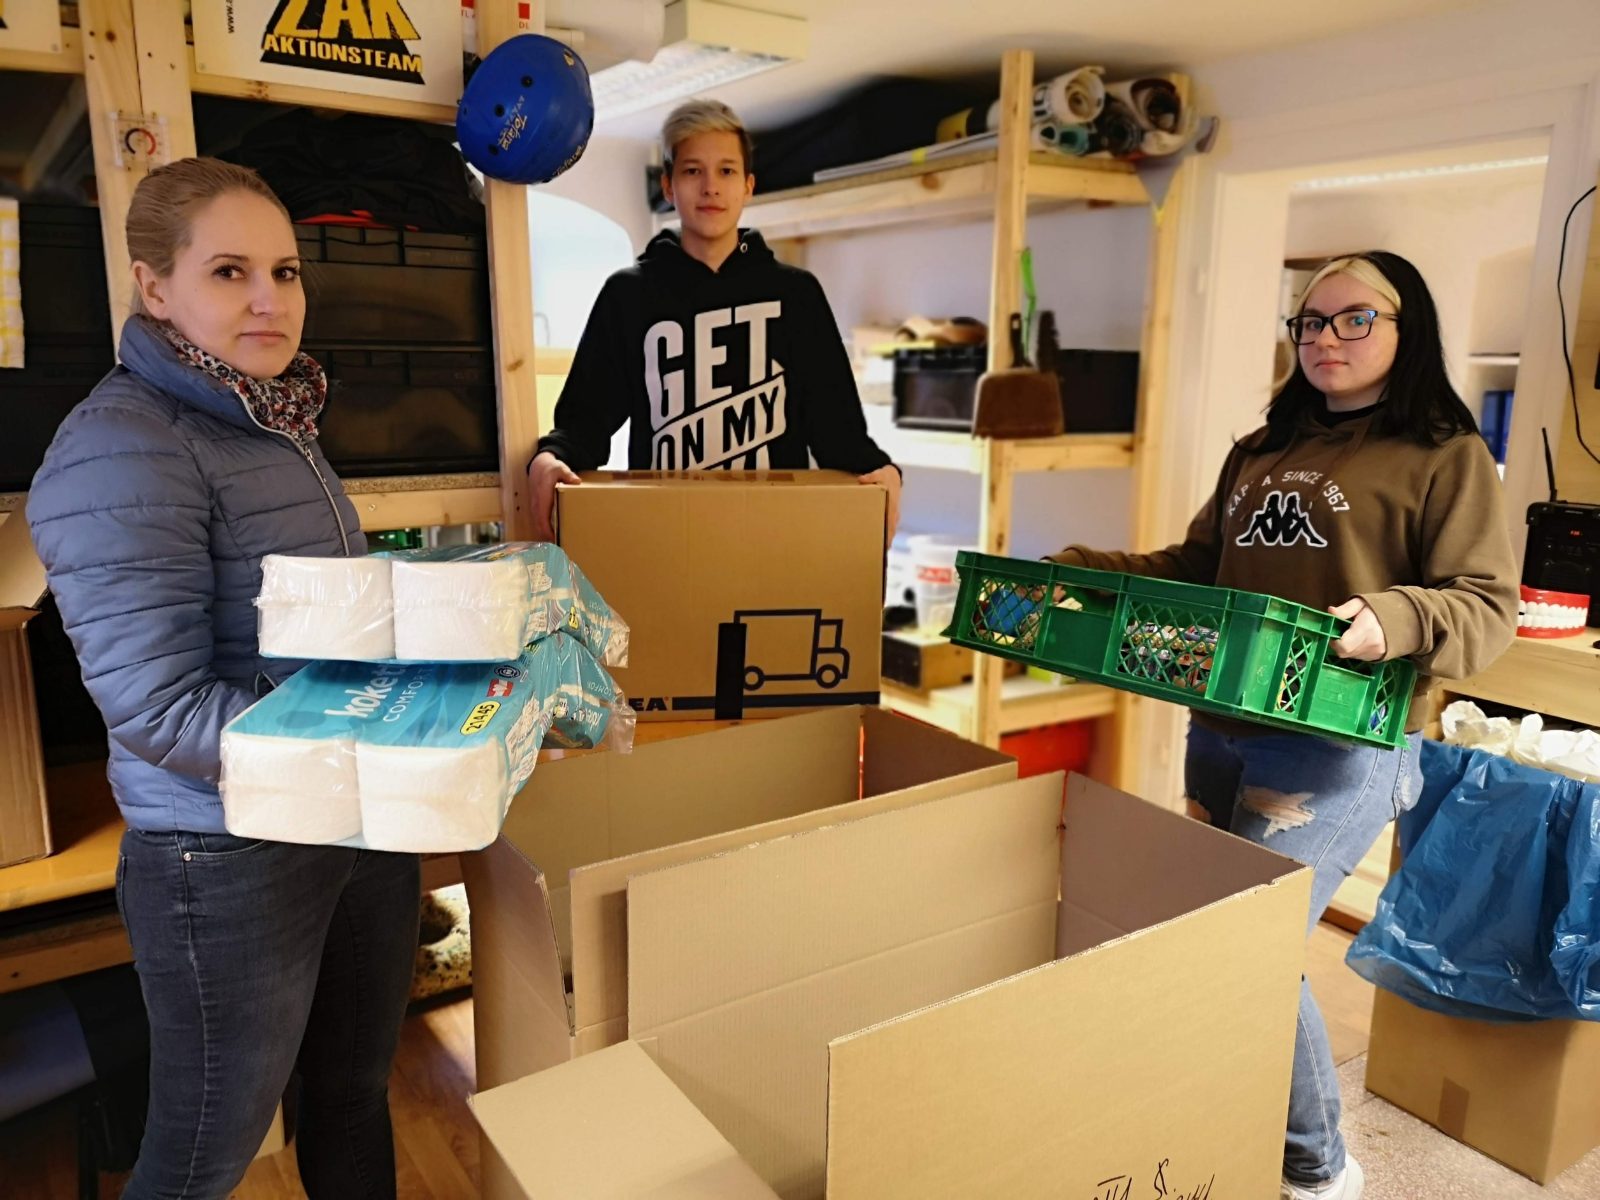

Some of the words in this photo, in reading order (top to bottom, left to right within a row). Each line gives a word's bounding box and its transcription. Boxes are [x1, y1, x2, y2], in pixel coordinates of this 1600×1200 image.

[262, 33, 424, 73] AKTIONSTEAM
[643, 300, 782, 432] GET
[656, 417, 705, 470] ON
[722, 385, 780, 454] MY
[1228, 475, 1272, 517] KAPA
[1282, 470, 1324, 485] SINCE
[628, 697, 668, 711] EA
